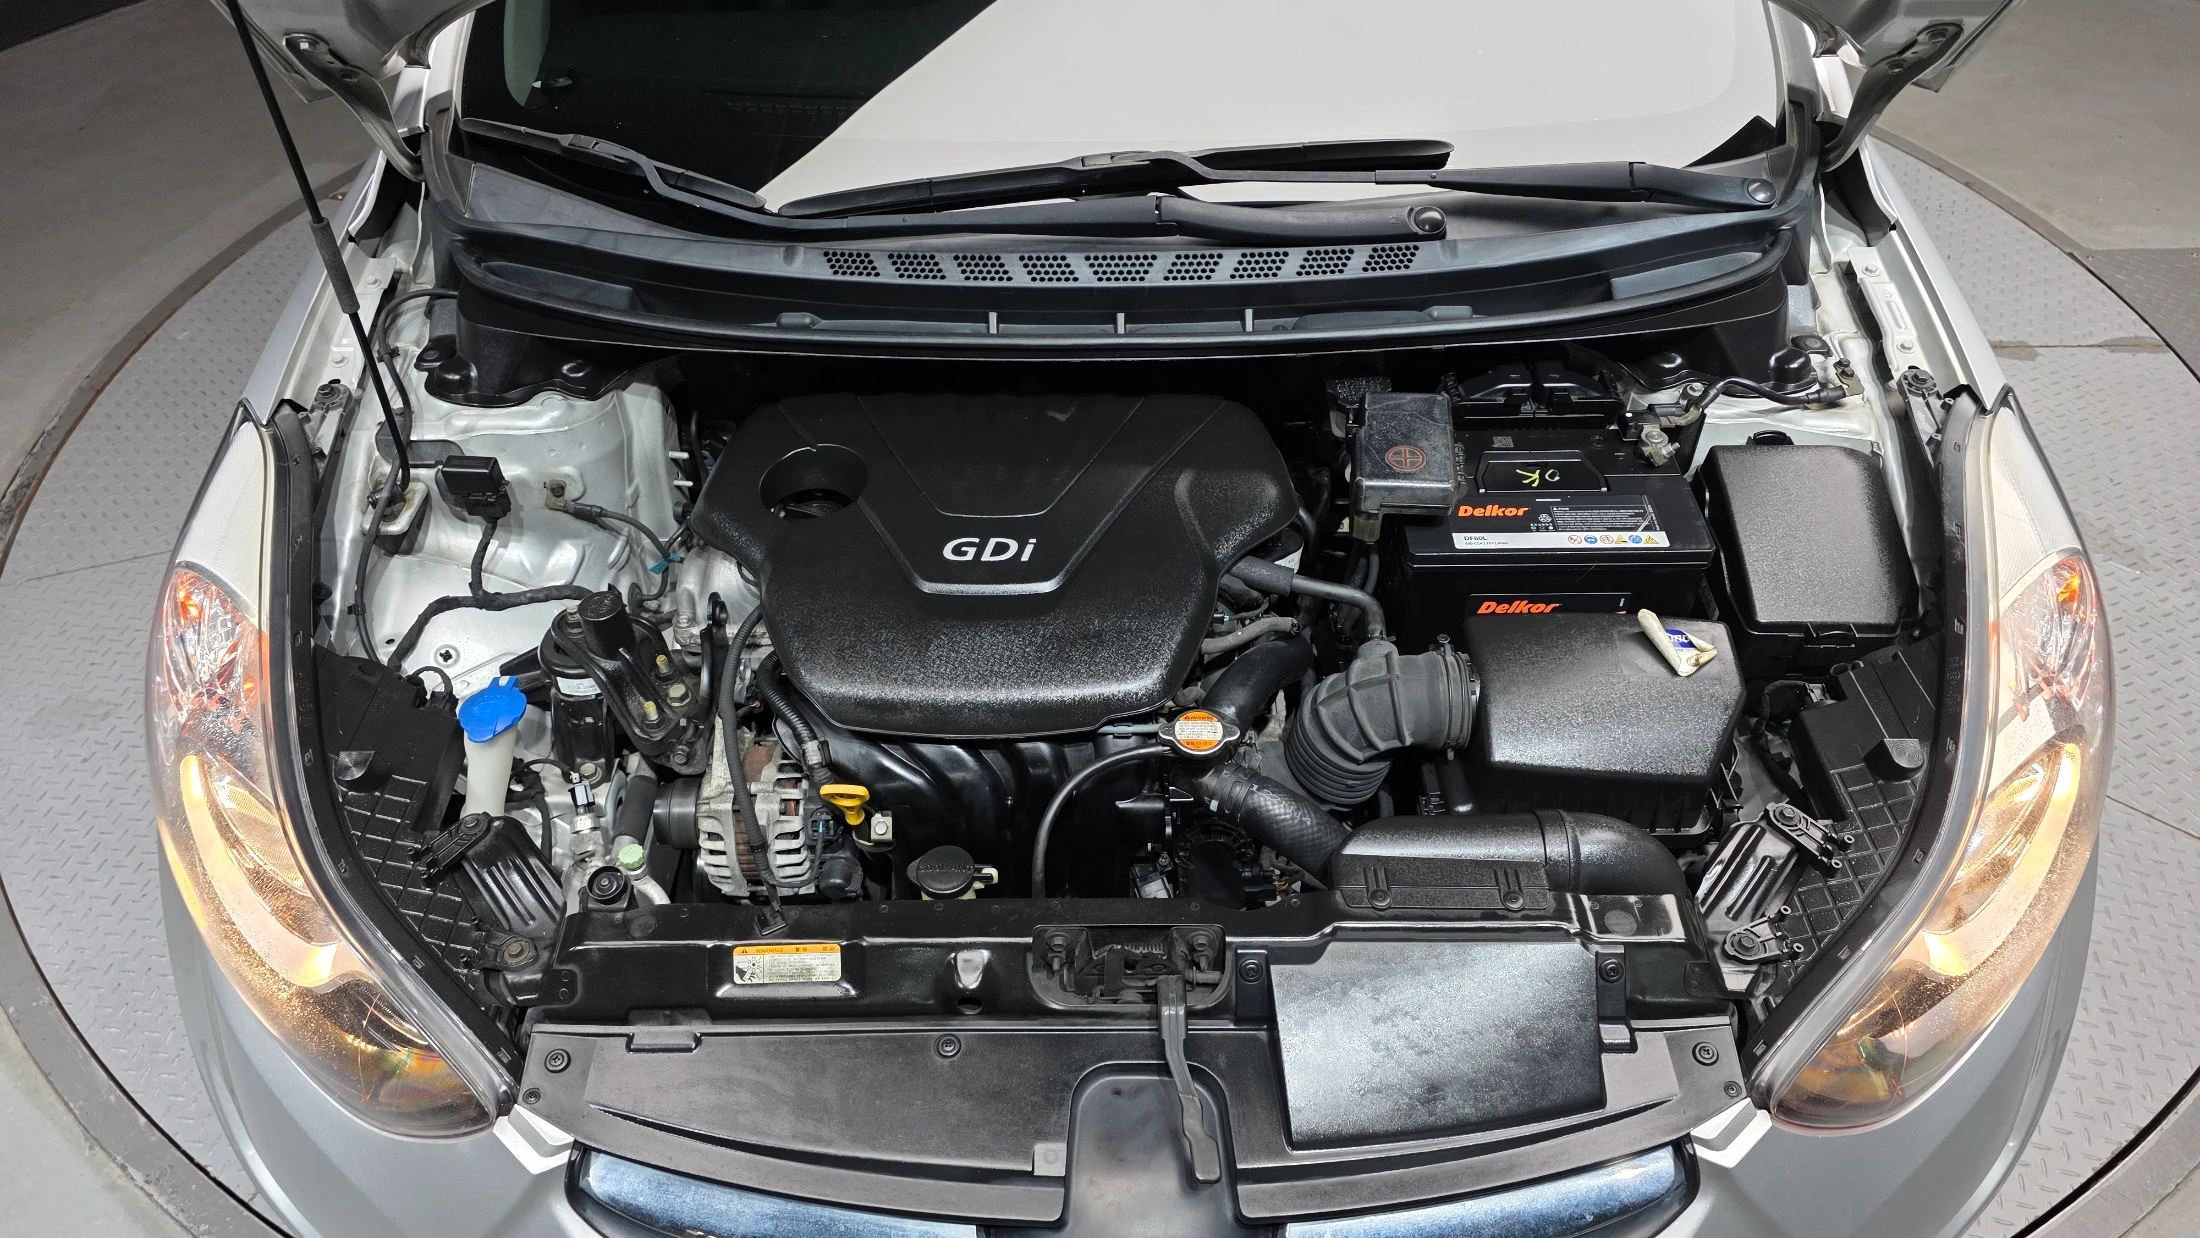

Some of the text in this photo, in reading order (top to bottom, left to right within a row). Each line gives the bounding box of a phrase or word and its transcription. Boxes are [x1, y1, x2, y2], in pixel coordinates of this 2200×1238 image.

[1458, 504, 1528, 517] Delkor
[942, 537, 1037, 562] GDi
[1476, 599, 1560, 614] Delkor
[917, 863, 974, 874] COOLANT
